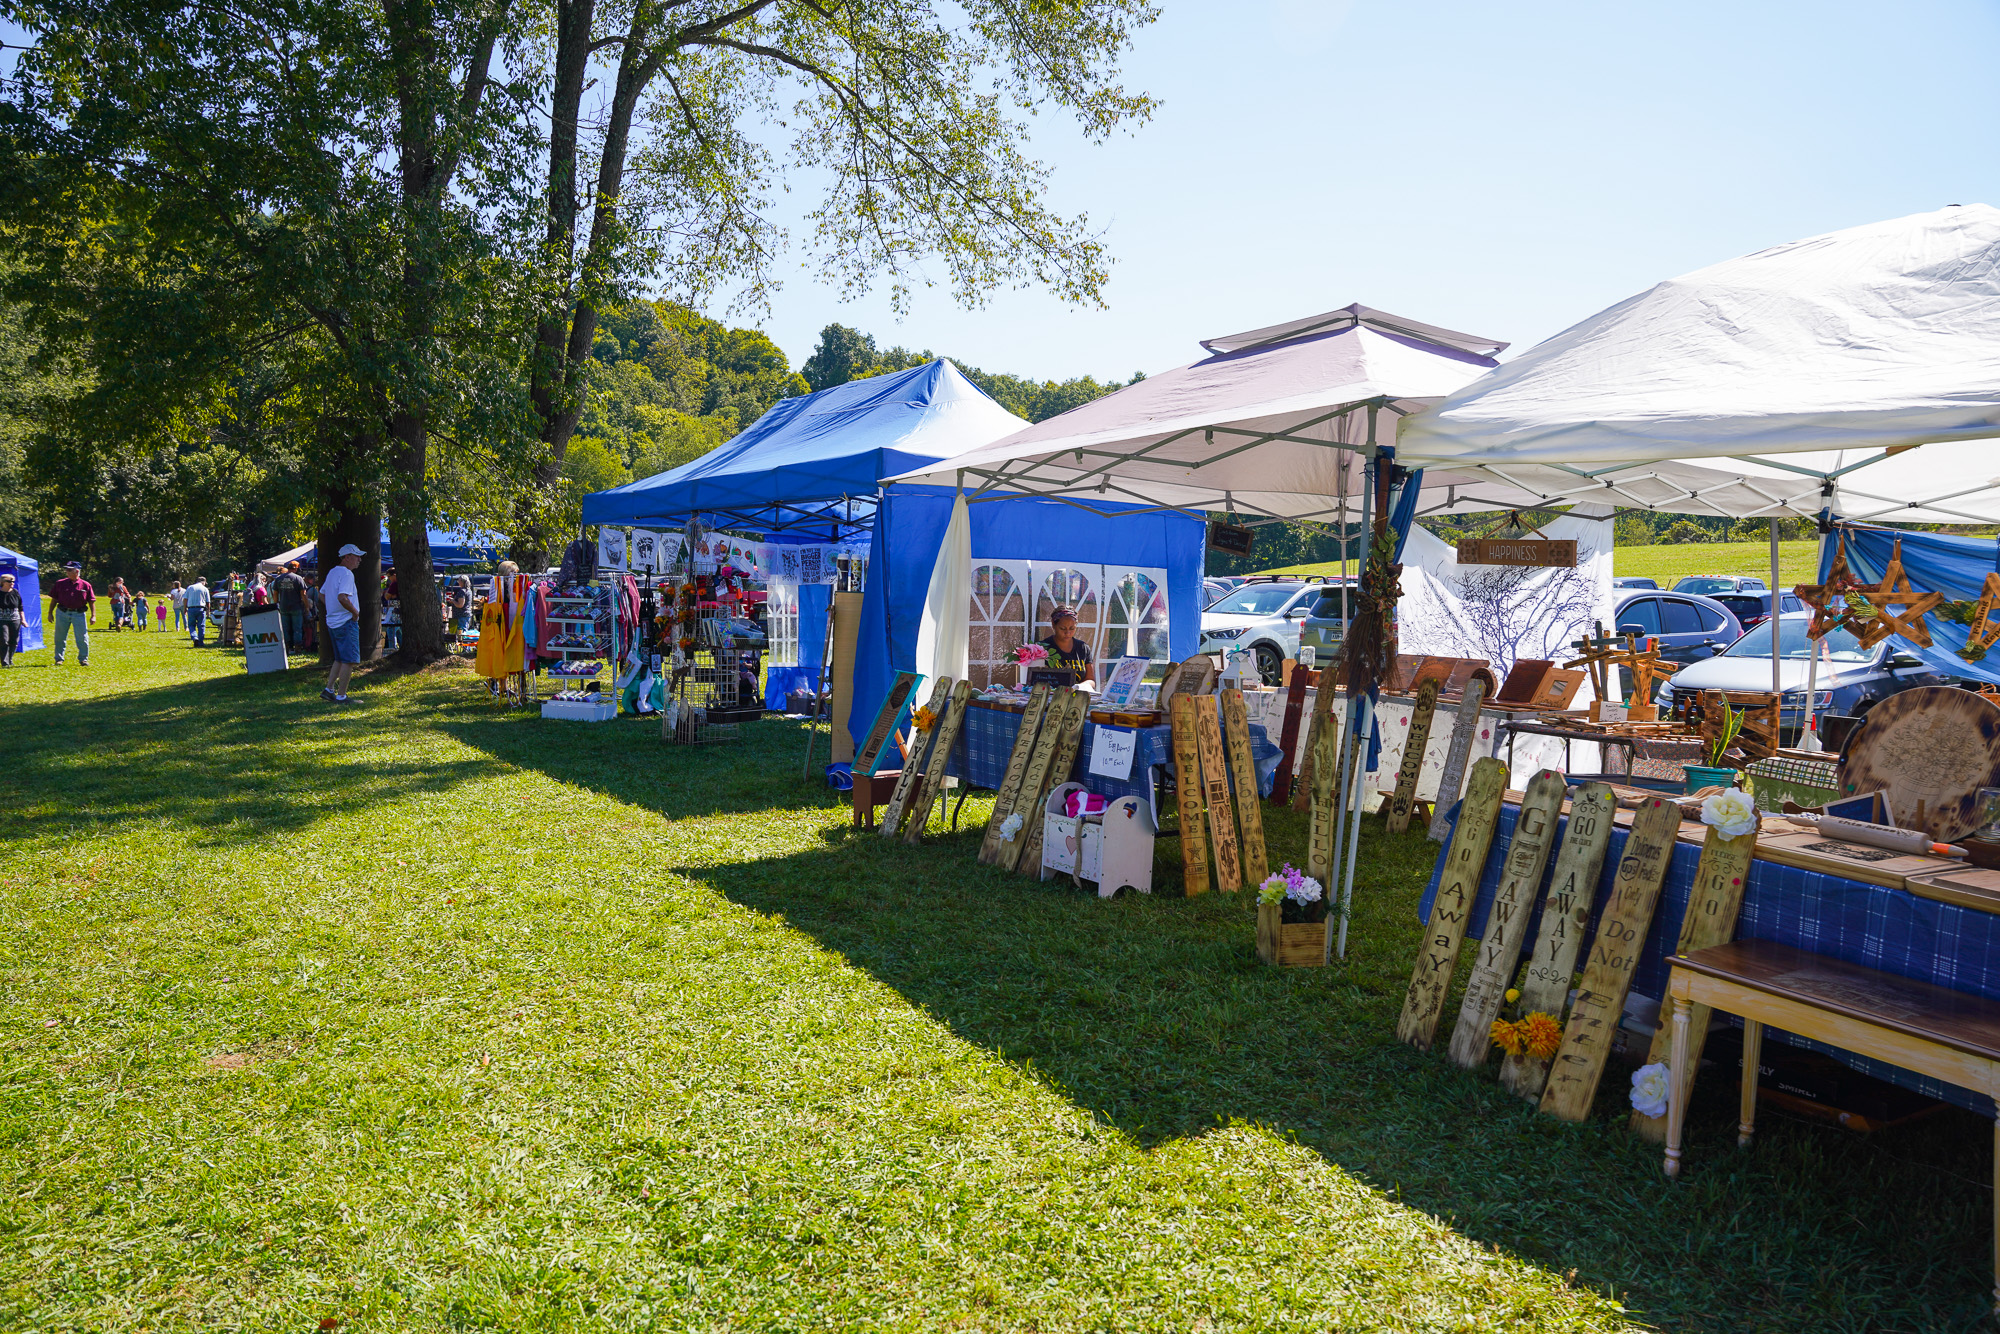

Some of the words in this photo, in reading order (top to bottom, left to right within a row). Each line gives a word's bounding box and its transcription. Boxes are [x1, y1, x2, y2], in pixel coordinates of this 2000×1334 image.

[1488, 545, 1537, 561] HAPPINESS
[1973, 600, 1989, 634] Fishing
[246, 632, 279, 644] WM
[1102, 729, 1113, 739] Kids
[1003, 728, 1036, 806] WELCOME
[1400, 723, 1426, 789] WELCOME
[1017, 740, 1055, 814] WELCOME
[1230, 740, 1255, 823] WELCOME
[1178, 752, 1200, 834] WELCOME
[1215, 812, 1223, 836] Welcome
[1312, 797, 1329, 866] HELLO
[1573, 815, 1596, 837] GO
[1864, 824, 1898, 834] Mess
[1569, 836, 1579, 845] THE
[1630, 836, 1662, 861] Deliveries
[1621, 864, 1637, 877] ups
[1624, 886, 1642, 906] Only
[1705, 875, 1725, 915] GO
[1487, 881, 1518, 968] AWAY
[1549, 871, 1578, 962] AWAY
[1605, 919, 1636, 942] Do
[1592, 945, 1634, 972] Not
[1556, 988, 1614, 1083] Enter
[1738, 1058, 1775, 1077] SRLY
